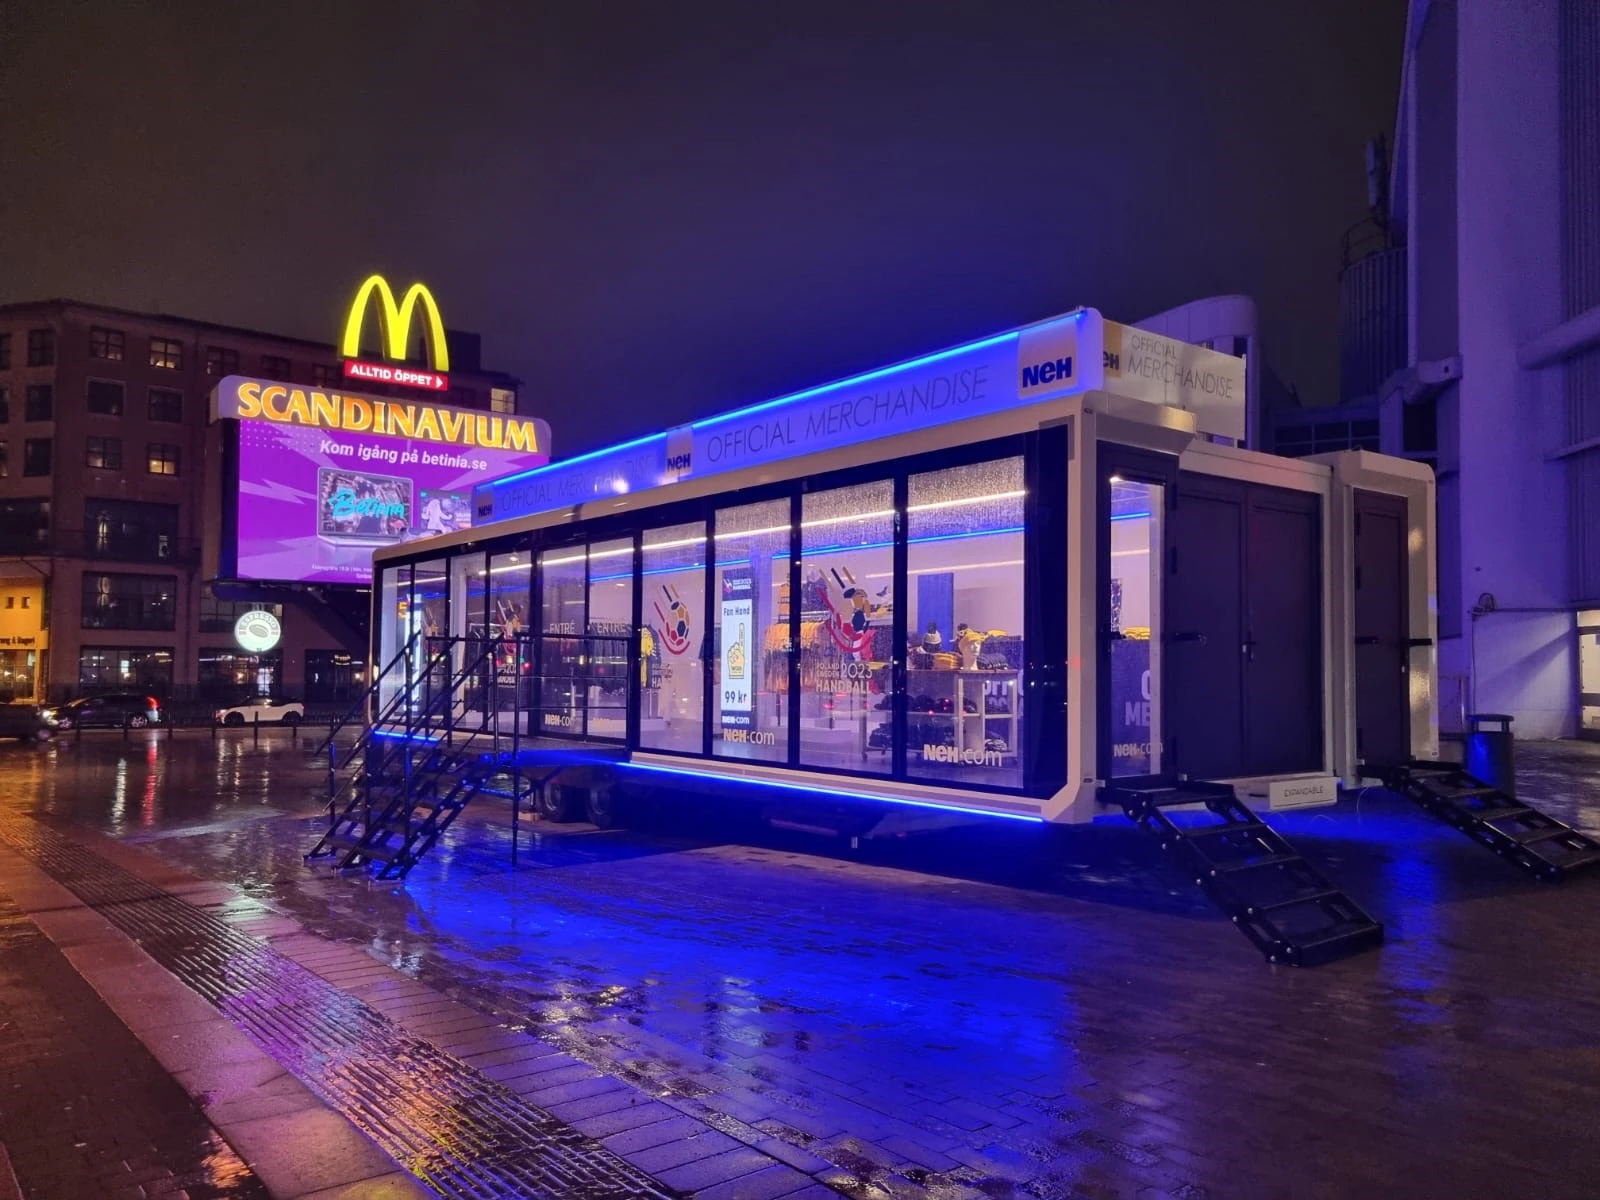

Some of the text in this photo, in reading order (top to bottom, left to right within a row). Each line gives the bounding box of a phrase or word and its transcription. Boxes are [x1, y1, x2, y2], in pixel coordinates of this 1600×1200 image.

[1130, 334, 1177, 360] OFFICIAL
[350, 365, 432, 387] ALLTID ÖPPET
[1127, 356, 1233, 399] MERCHANDISE
[237, 383, 539, 453] SCANDINAVIUM
[706, 365, 989, 463] OFFICIAL MERCHANDISE
[319, 439, 488, 471] Kom igång på betinia.se
[502, 486, 552, 512] OFFICIAL
[841, 662, 873, 679] 2023
[724, 690, 747, 704] 99 kr
[815, 679, 872, 695] HANDBALL
